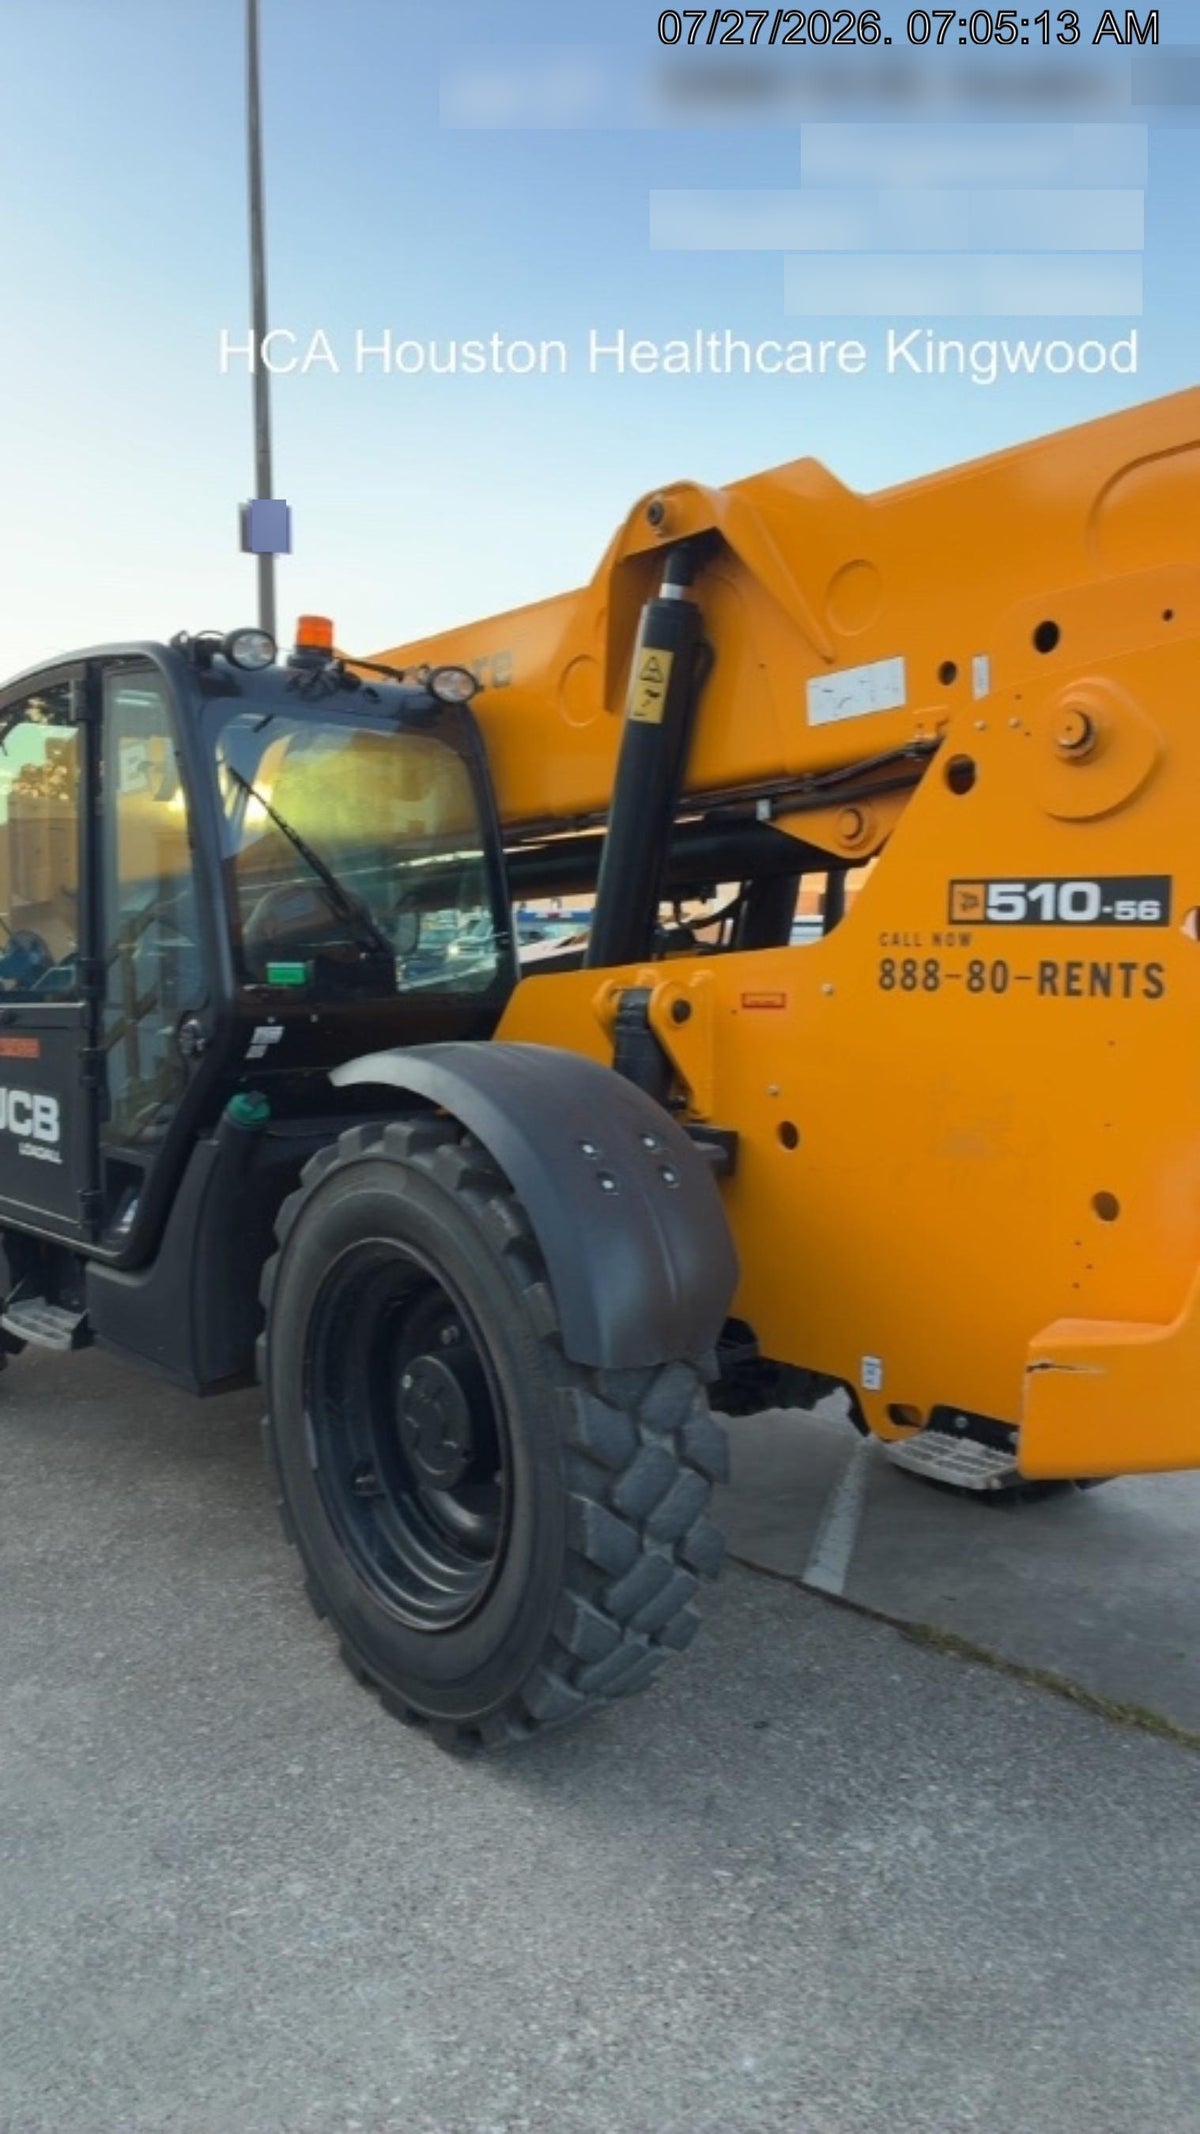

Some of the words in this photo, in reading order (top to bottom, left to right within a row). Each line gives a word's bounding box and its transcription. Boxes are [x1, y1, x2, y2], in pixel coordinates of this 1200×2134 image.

[986, 881, 1161, 922] 510-56
[879, 931, 923, 947] CALL
[932, 931, 972, 947] NOW
[879, 957, 1164, 1000] 888-80-RENTS
